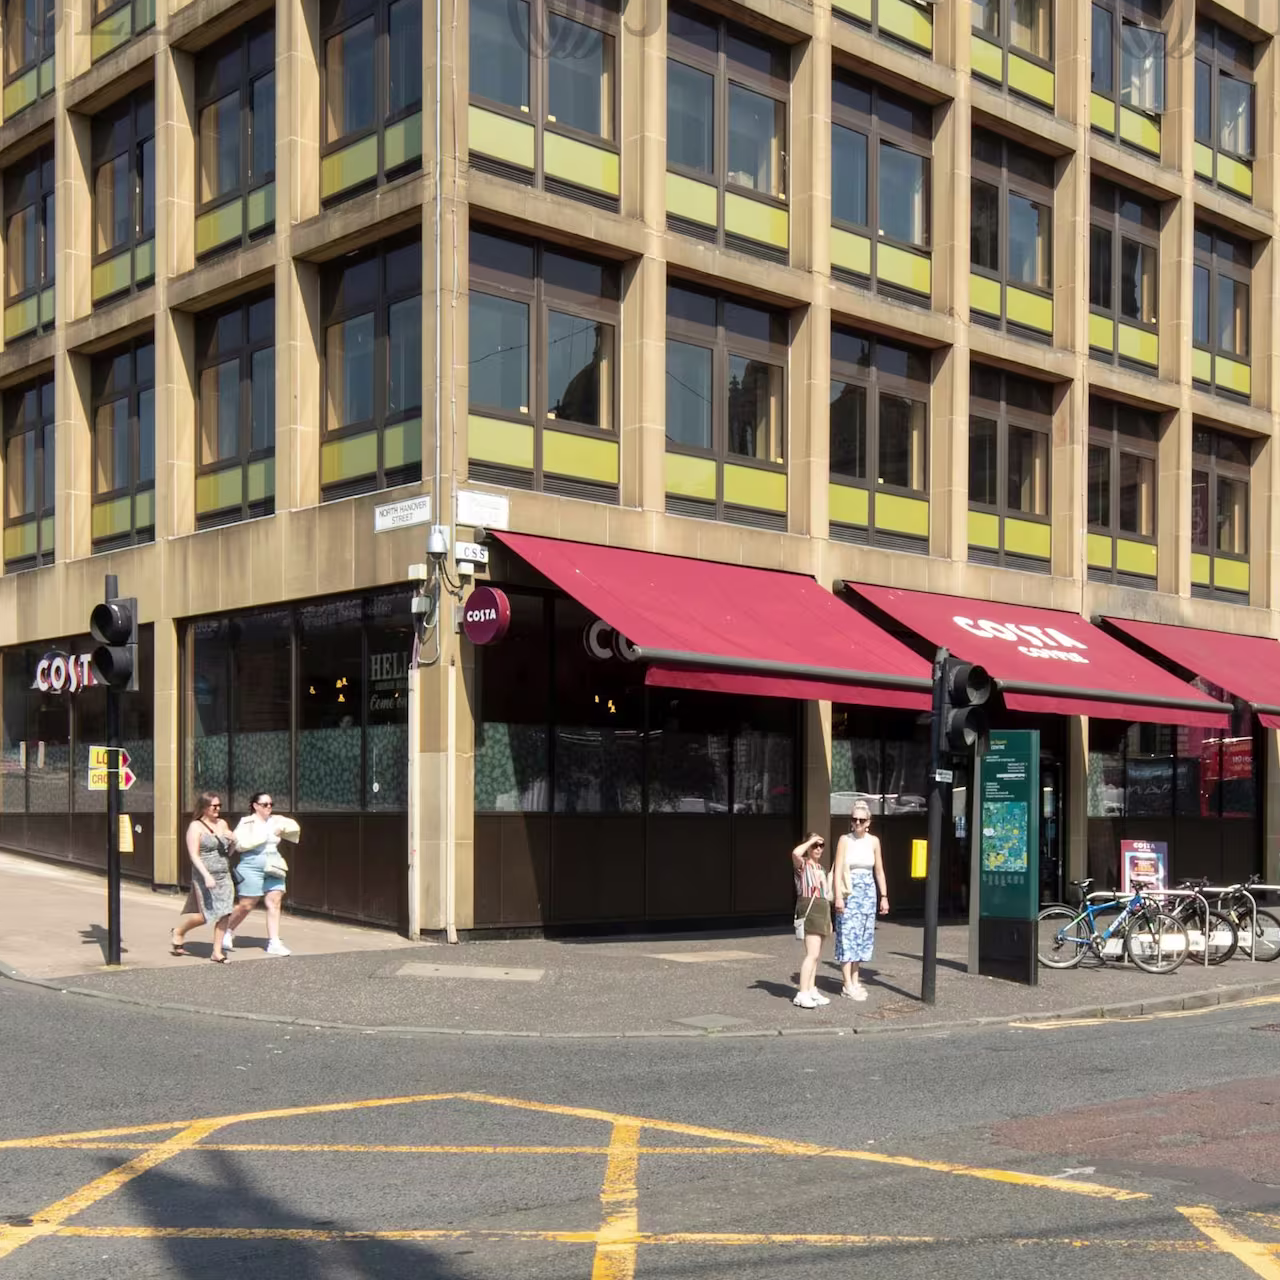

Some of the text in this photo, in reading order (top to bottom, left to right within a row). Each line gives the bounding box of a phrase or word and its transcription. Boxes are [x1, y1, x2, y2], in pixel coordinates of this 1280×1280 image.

[379, 500, 427, 518] NORTH HANOVER
[391, 513, 413, 525] STREET
[466, 608, 496, 622] COSTA
[952, 615, 1088, 649] COSTA
[36, 653, 96, 693] COST
[96, 751, 109, 765] LO
[92, 774, 123, 784] CROD
